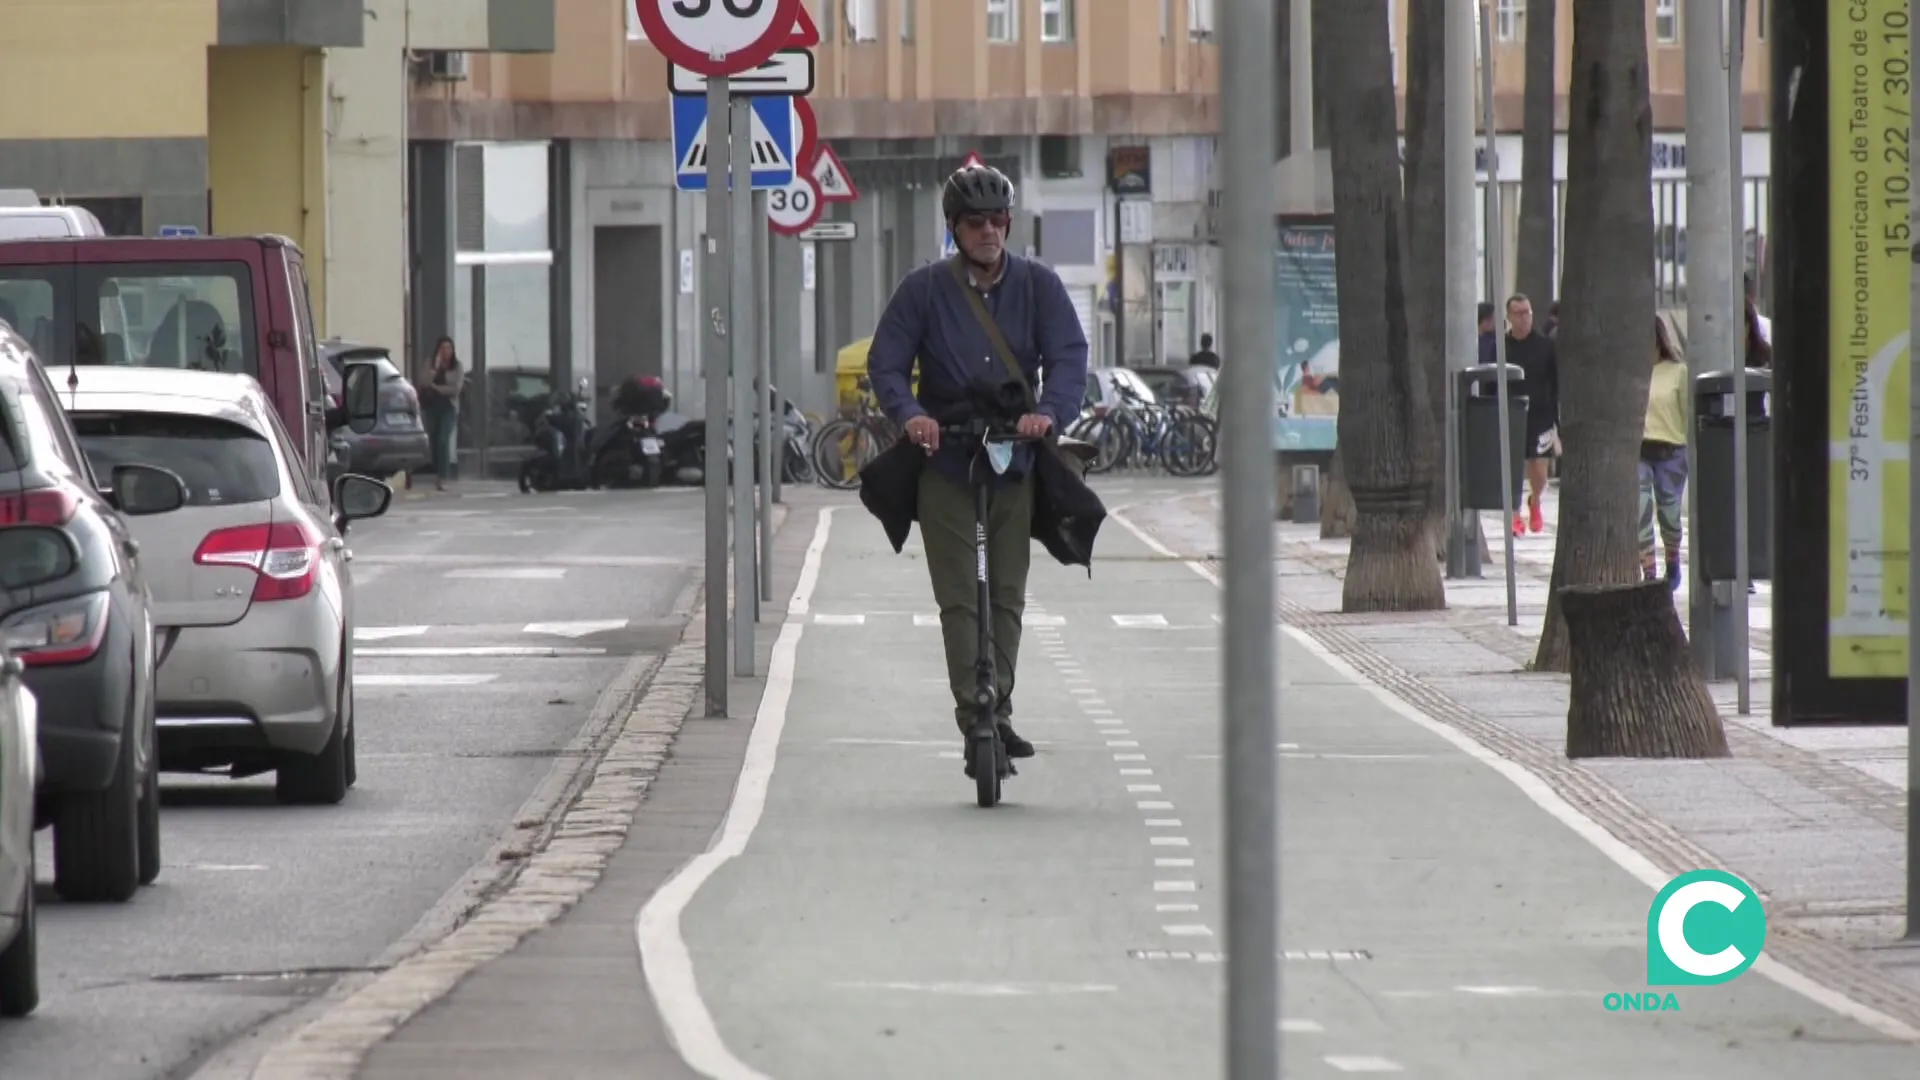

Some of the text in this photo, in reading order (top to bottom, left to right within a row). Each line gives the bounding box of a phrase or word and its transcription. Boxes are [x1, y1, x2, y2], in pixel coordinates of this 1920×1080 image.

[1849, 29, 1868, 56] de
[1849, 64, 1868, 133] Teatro
[1849, 136, 1868, 162] de
[771, 189, 808, 212] 30
[1884, 127, 1910, 258] 15.10.22
[1850, 170, 1869, 346] Iberoamericano
[1849, 354, 1869, 438] Festival
